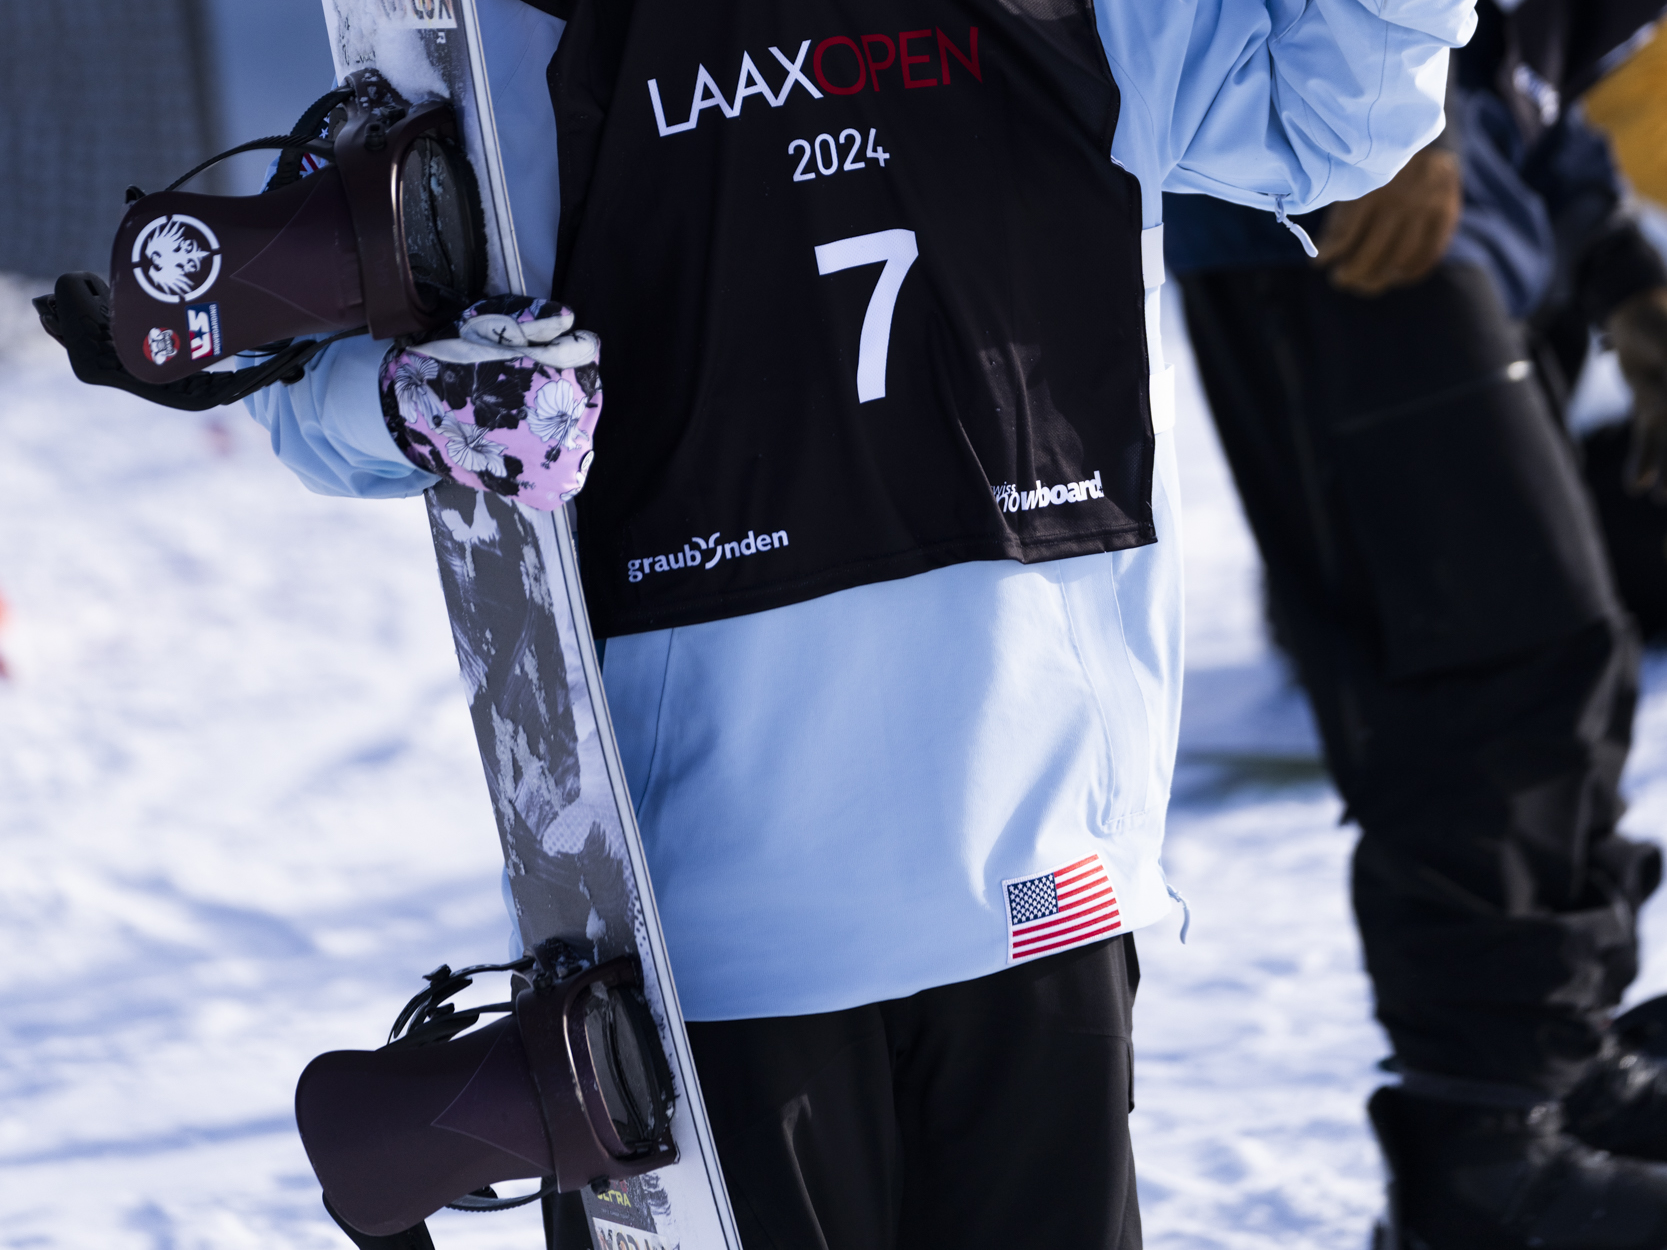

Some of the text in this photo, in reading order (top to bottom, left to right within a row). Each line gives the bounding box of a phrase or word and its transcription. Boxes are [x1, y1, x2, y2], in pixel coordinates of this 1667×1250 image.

[787, 127, 890, 182] 2024
[209, 304, 221, 356] SNOWBOARDING
[814, 228, 920, 403] 7
[996, 470, 1105, 513] nowboard
